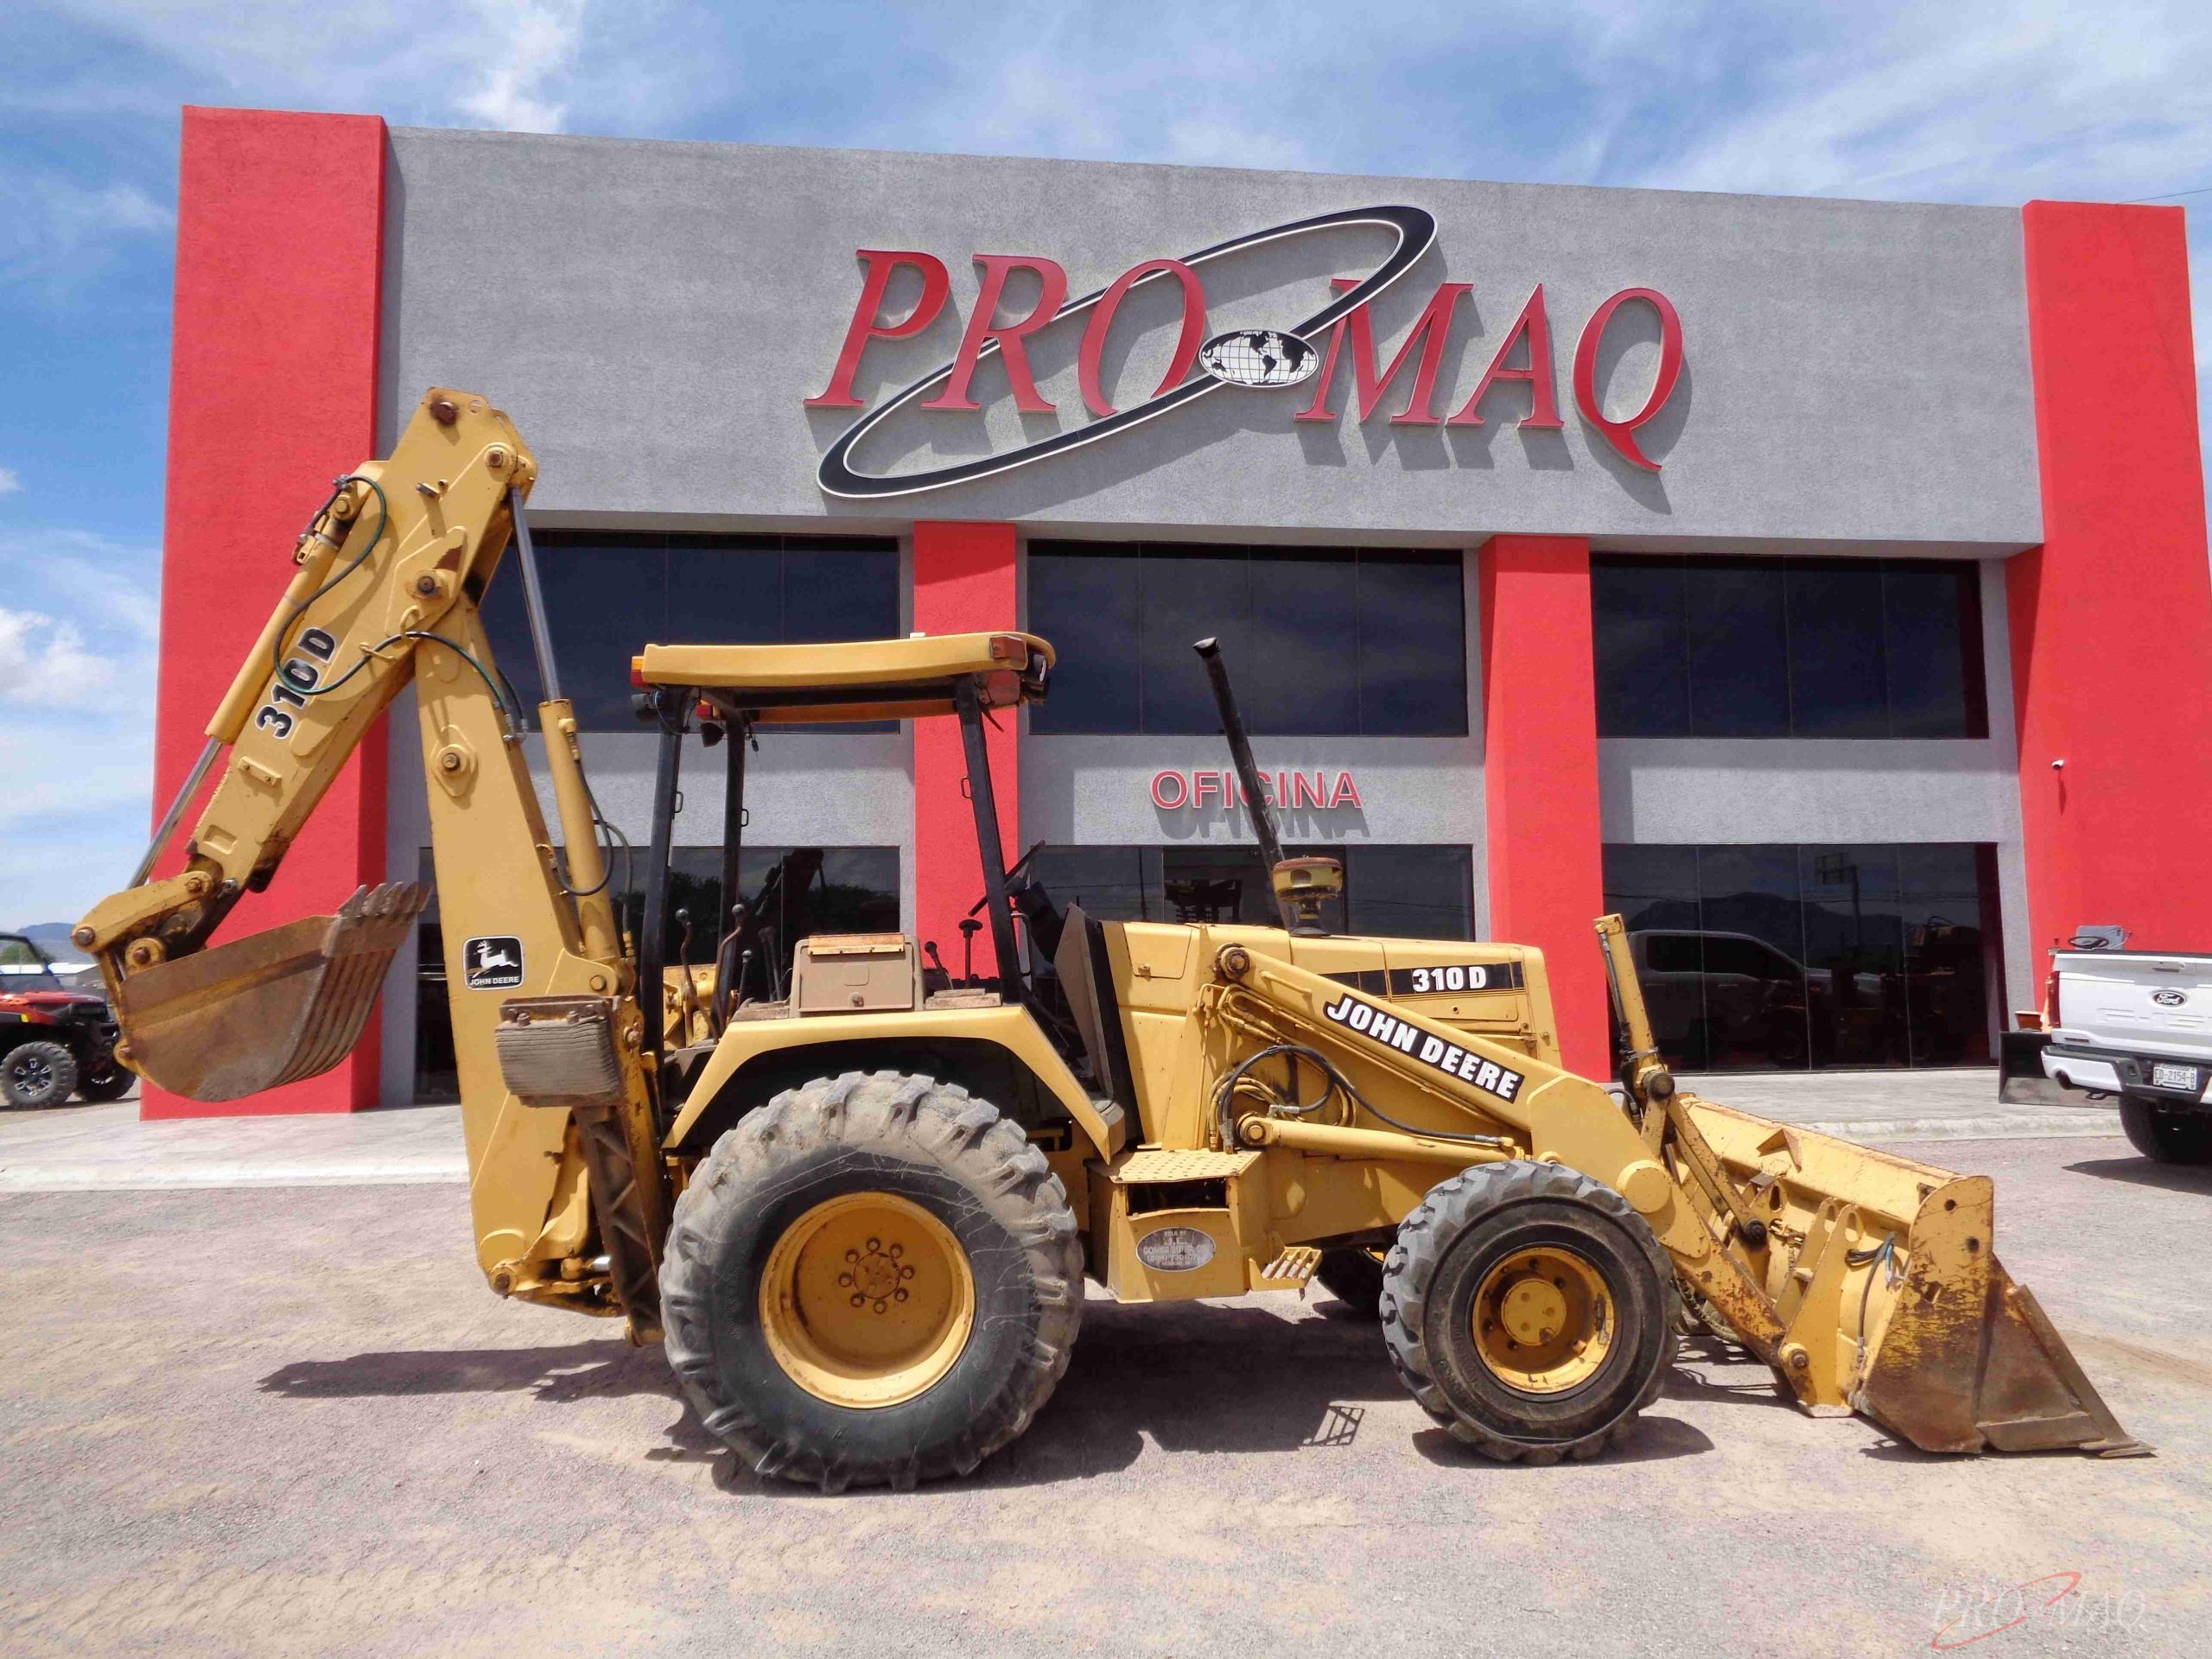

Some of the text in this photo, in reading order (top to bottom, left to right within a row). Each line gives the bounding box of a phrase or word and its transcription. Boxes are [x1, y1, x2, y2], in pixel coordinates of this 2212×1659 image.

[804, 248, 1685, 472] PRO MAQ
[493, 976, 520, 984] DEERE
[2157, 992, 2181, 1005] Ford
[1326, 996, 1520, 1100] JOHN DEERE
